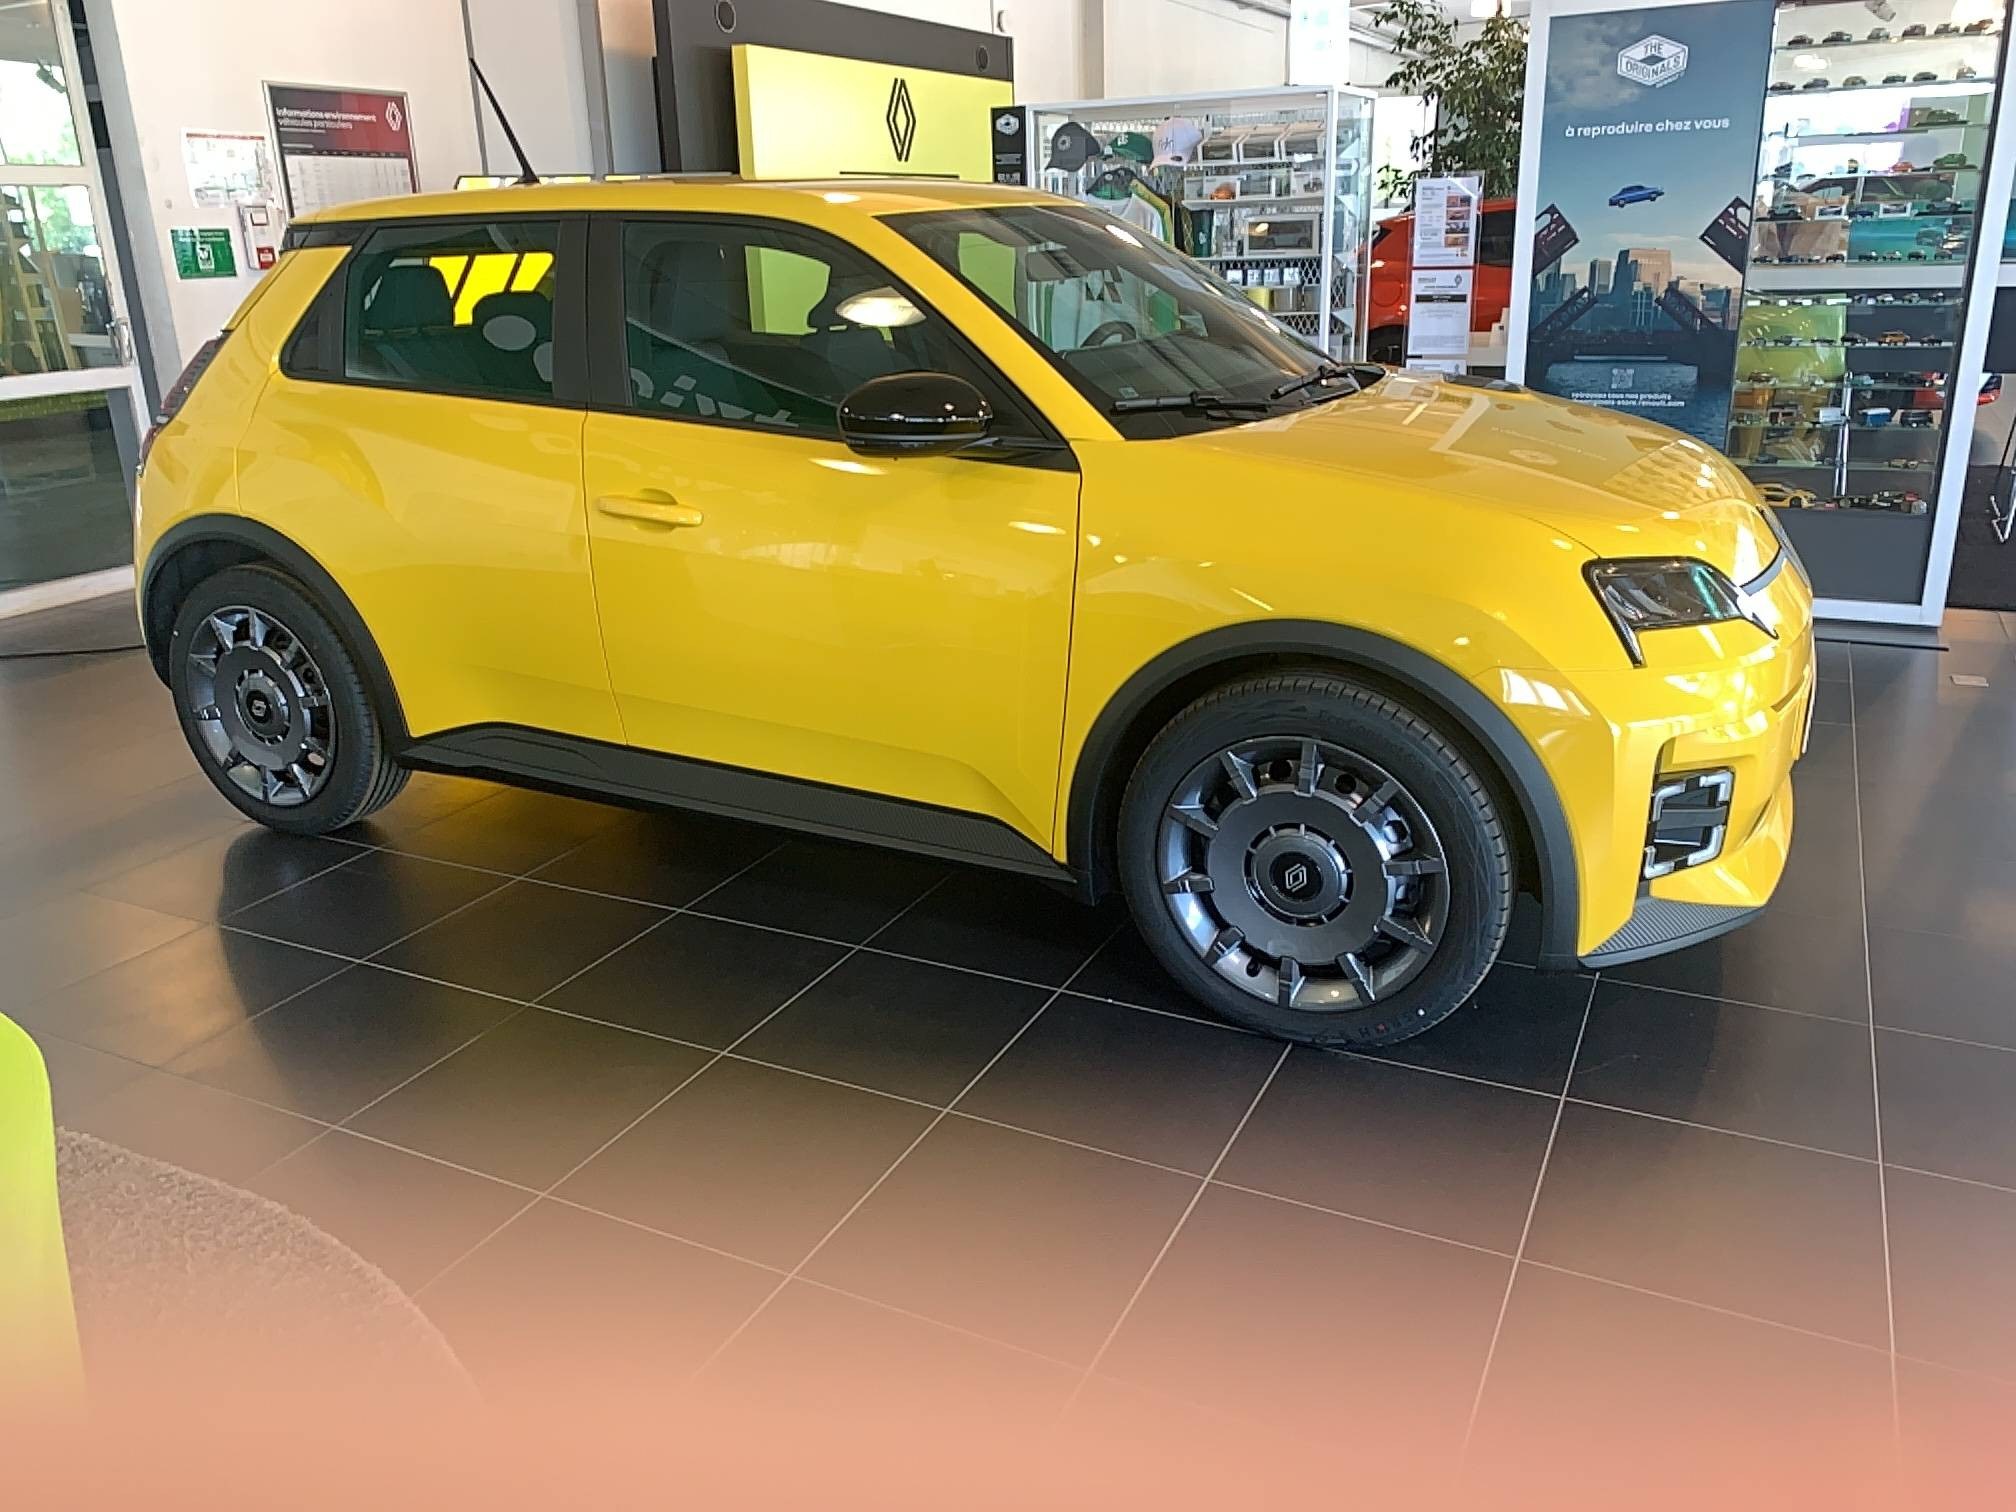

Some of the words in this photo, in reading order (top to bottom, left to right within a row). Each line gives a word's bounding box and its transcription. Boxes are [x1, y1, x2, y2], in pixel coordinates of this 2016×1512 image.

[1643, 41, 1664, 56] THE
[1625, 55, 1681, 79] ORIGINALS
[1565, 125, 1575, 137] à
[1577, 120, 1653, 139] reproduire
[1655, 119, 1691, 132] chez
[1693, 117, 1730, 130] vous
